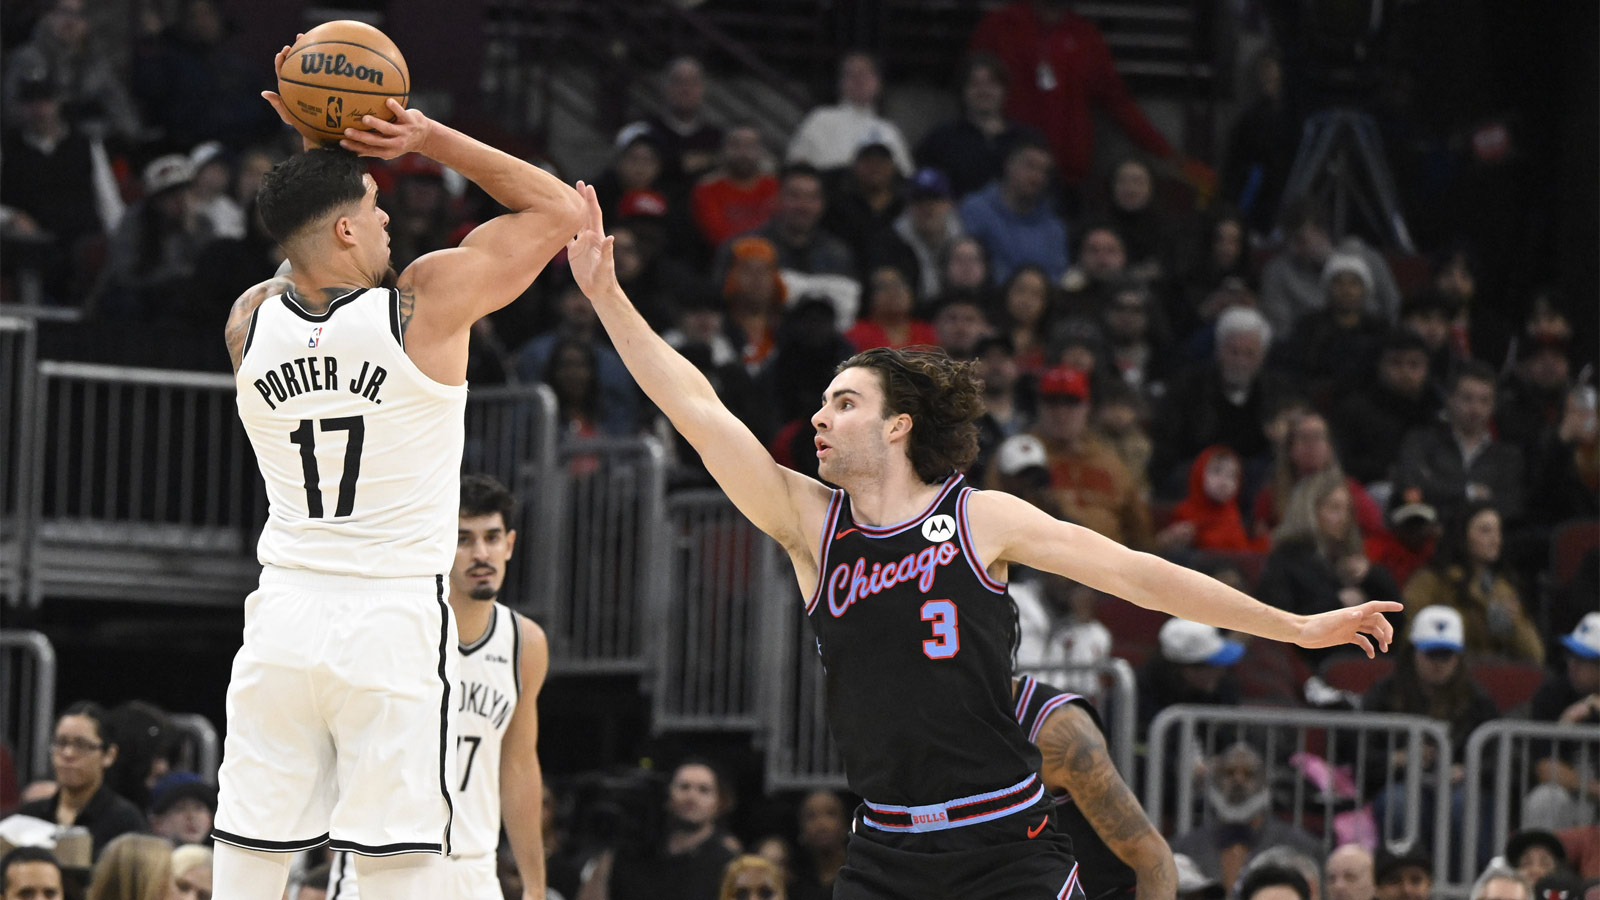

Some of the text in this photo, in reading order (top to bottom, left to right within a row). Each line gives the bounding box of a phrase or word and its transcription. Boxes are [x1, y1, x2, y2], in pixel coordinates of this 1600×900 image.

[301, 53, 383, 86] Wilson
[254, 356, 387, 410] PORTER JR.
[290, 415, 365, 518] 17
[828, 541, 959, 617] Chicago
[920, 599, 960, 659] 3
[913, 812, 946, 824] BULLS
